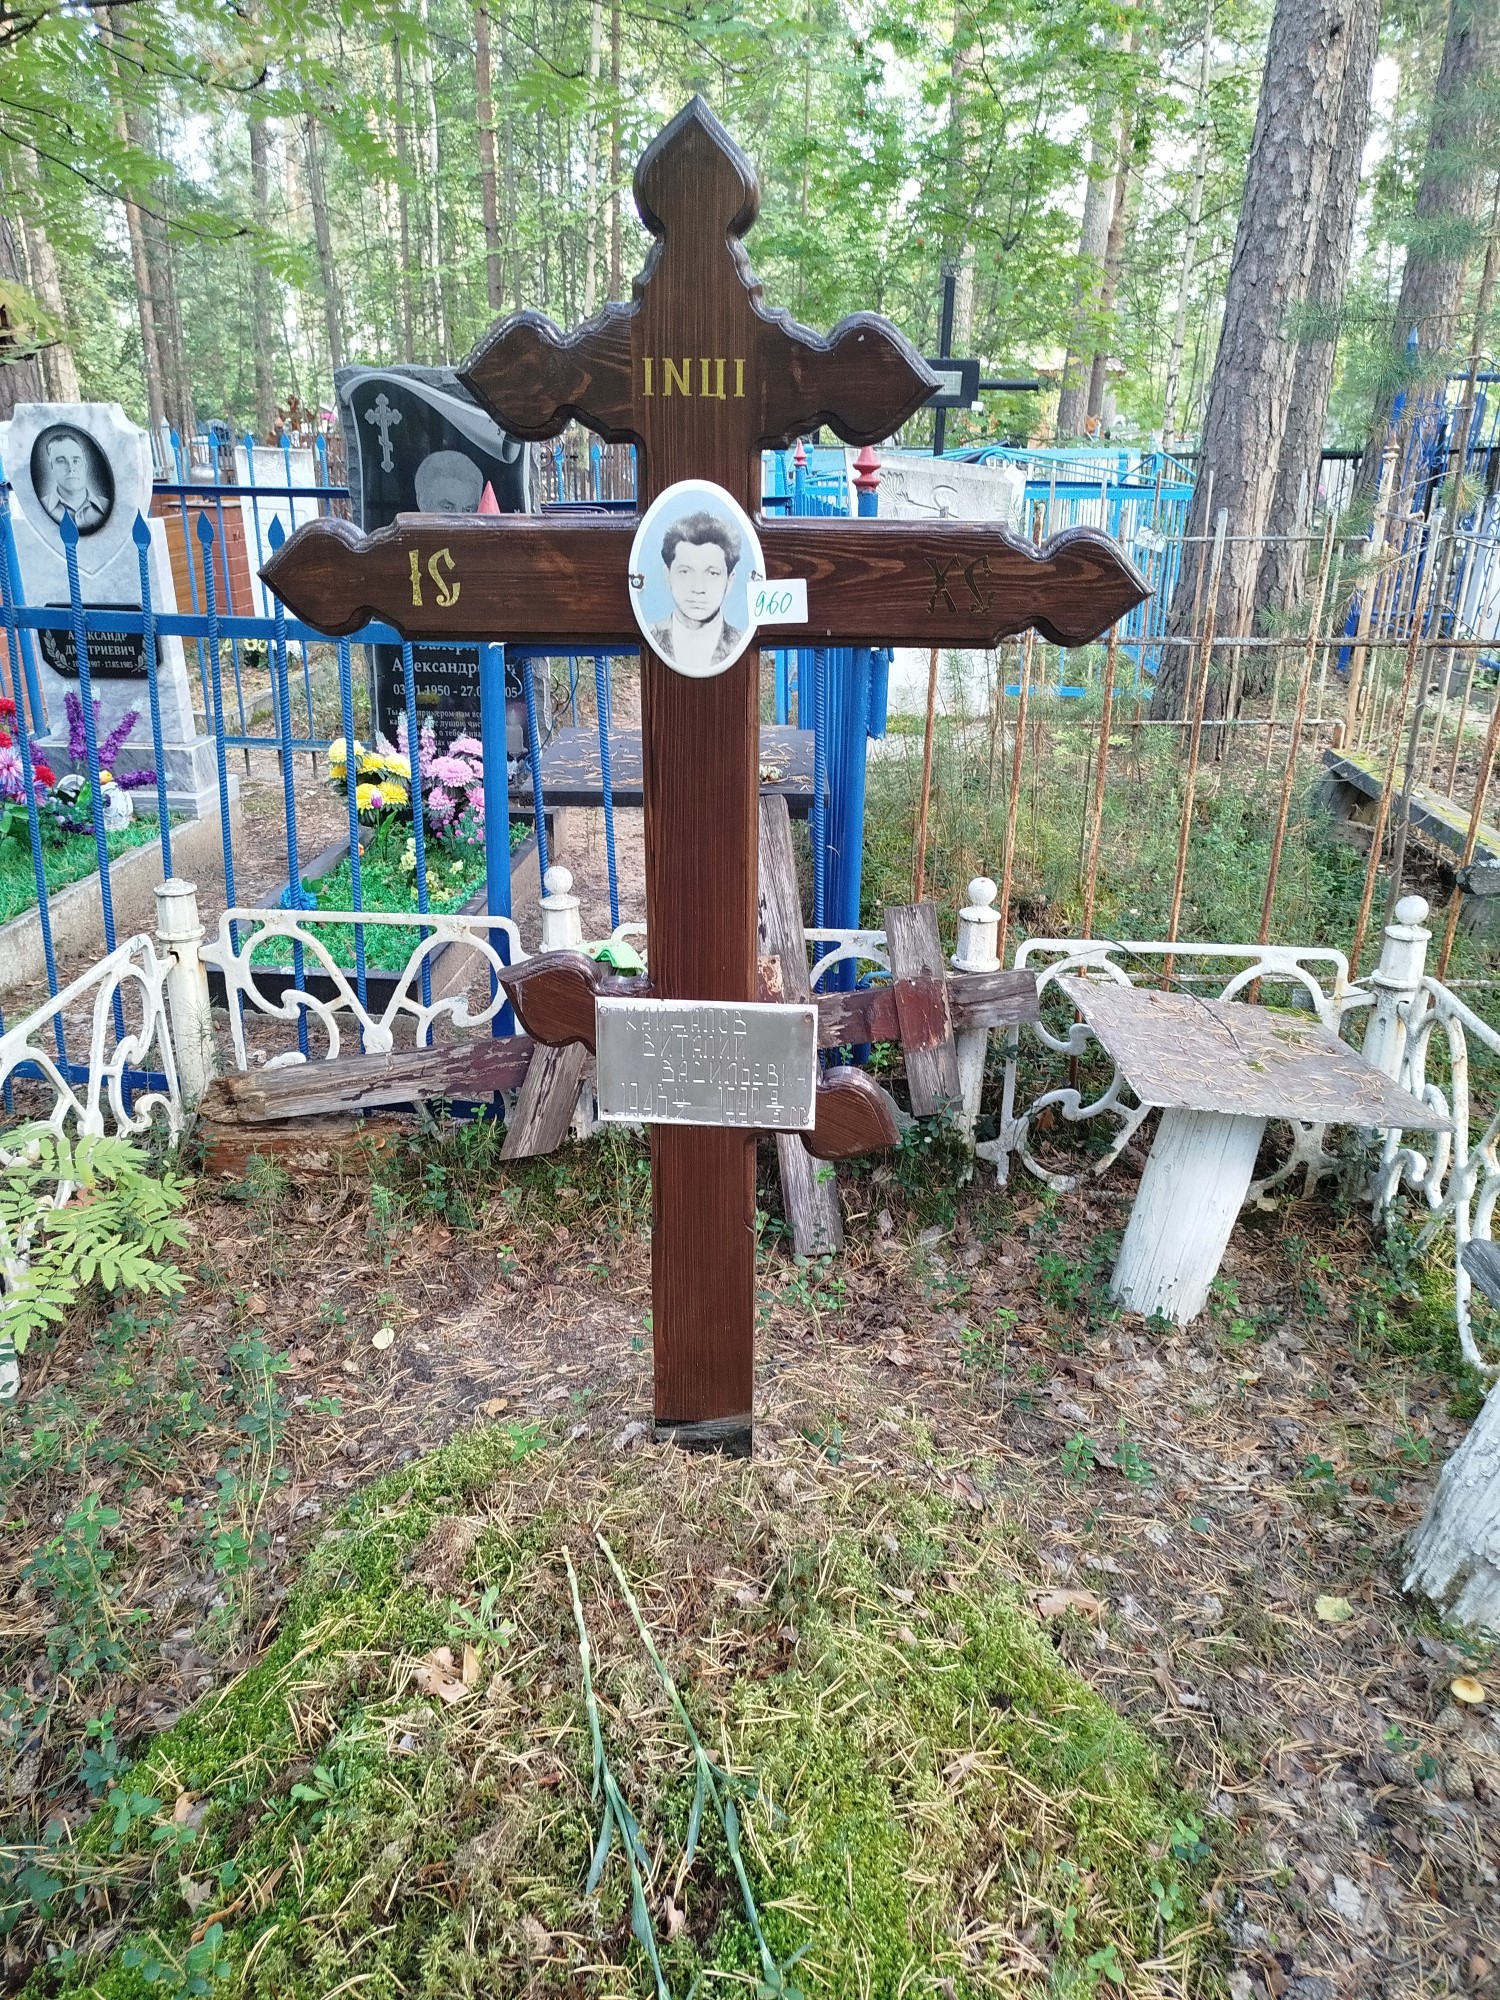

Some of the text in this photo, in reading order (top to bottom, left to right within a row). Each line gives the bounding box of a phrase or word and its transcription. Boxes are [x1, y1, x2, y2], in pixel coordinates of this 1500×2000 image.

[754, 591, 792, 617] 960
[66, 645, 135, 656] ДМТРИЕВИЧ
[392, 658, 516, 678] Аександрч
